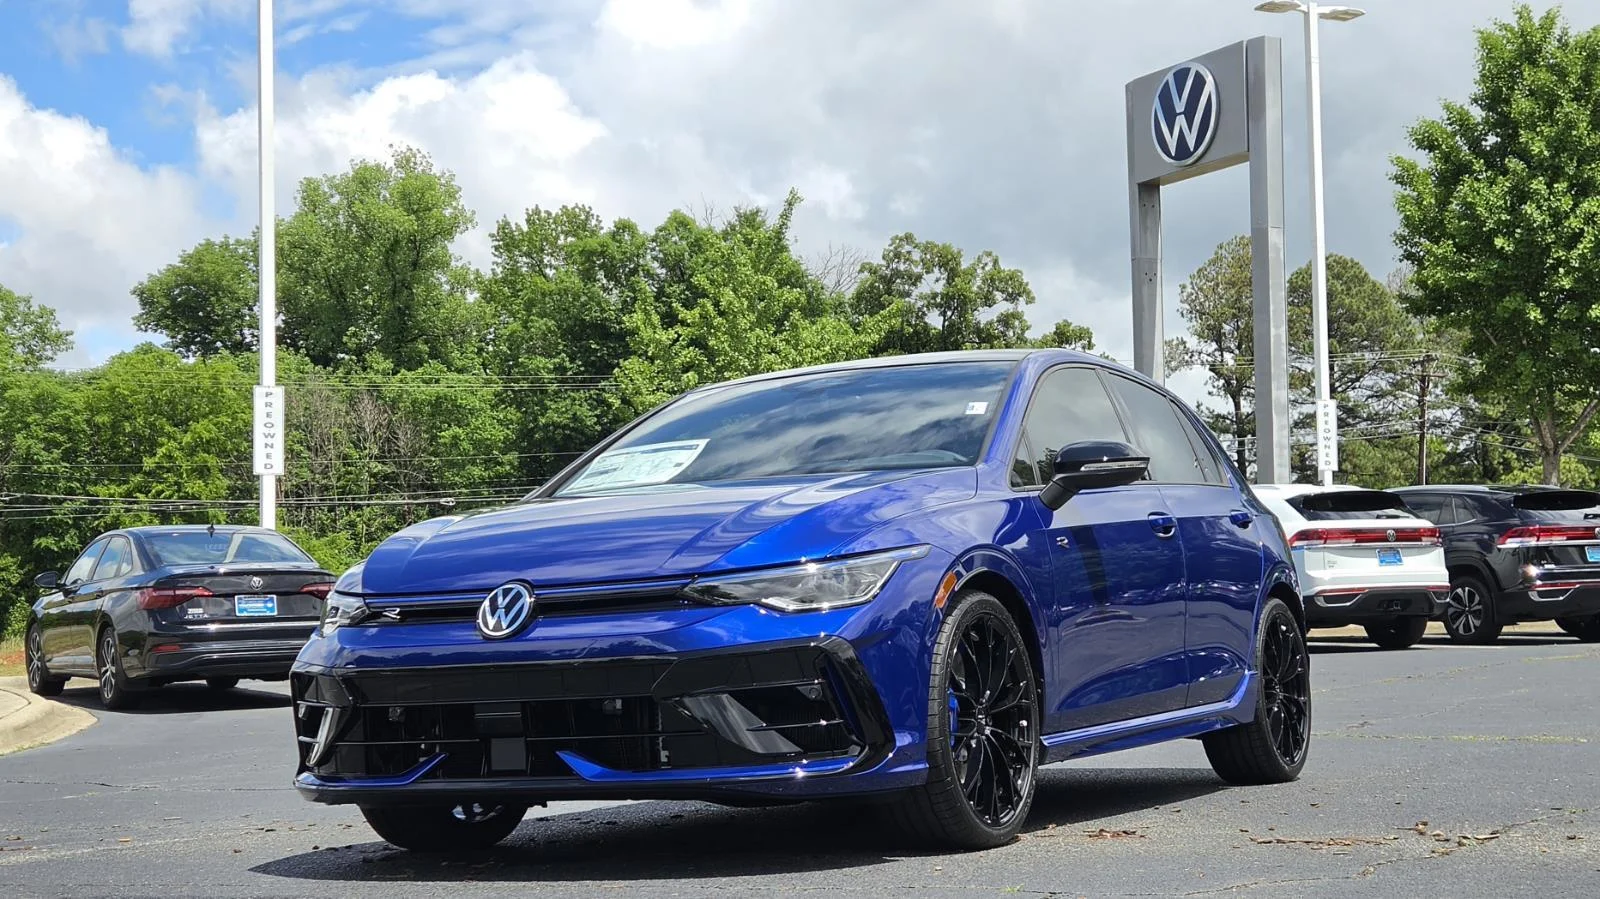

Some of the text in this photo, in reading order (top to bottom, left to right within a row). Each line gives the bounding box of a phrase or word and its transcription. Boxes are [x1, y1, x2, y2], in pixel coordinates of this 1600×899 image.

[1152, 62, 1219, 166] VW
[262, 391, 276, 470] PREOWNED
[1323, 403, 1332, 466] PREOWNED
[477, 582, 534, 638] VW
